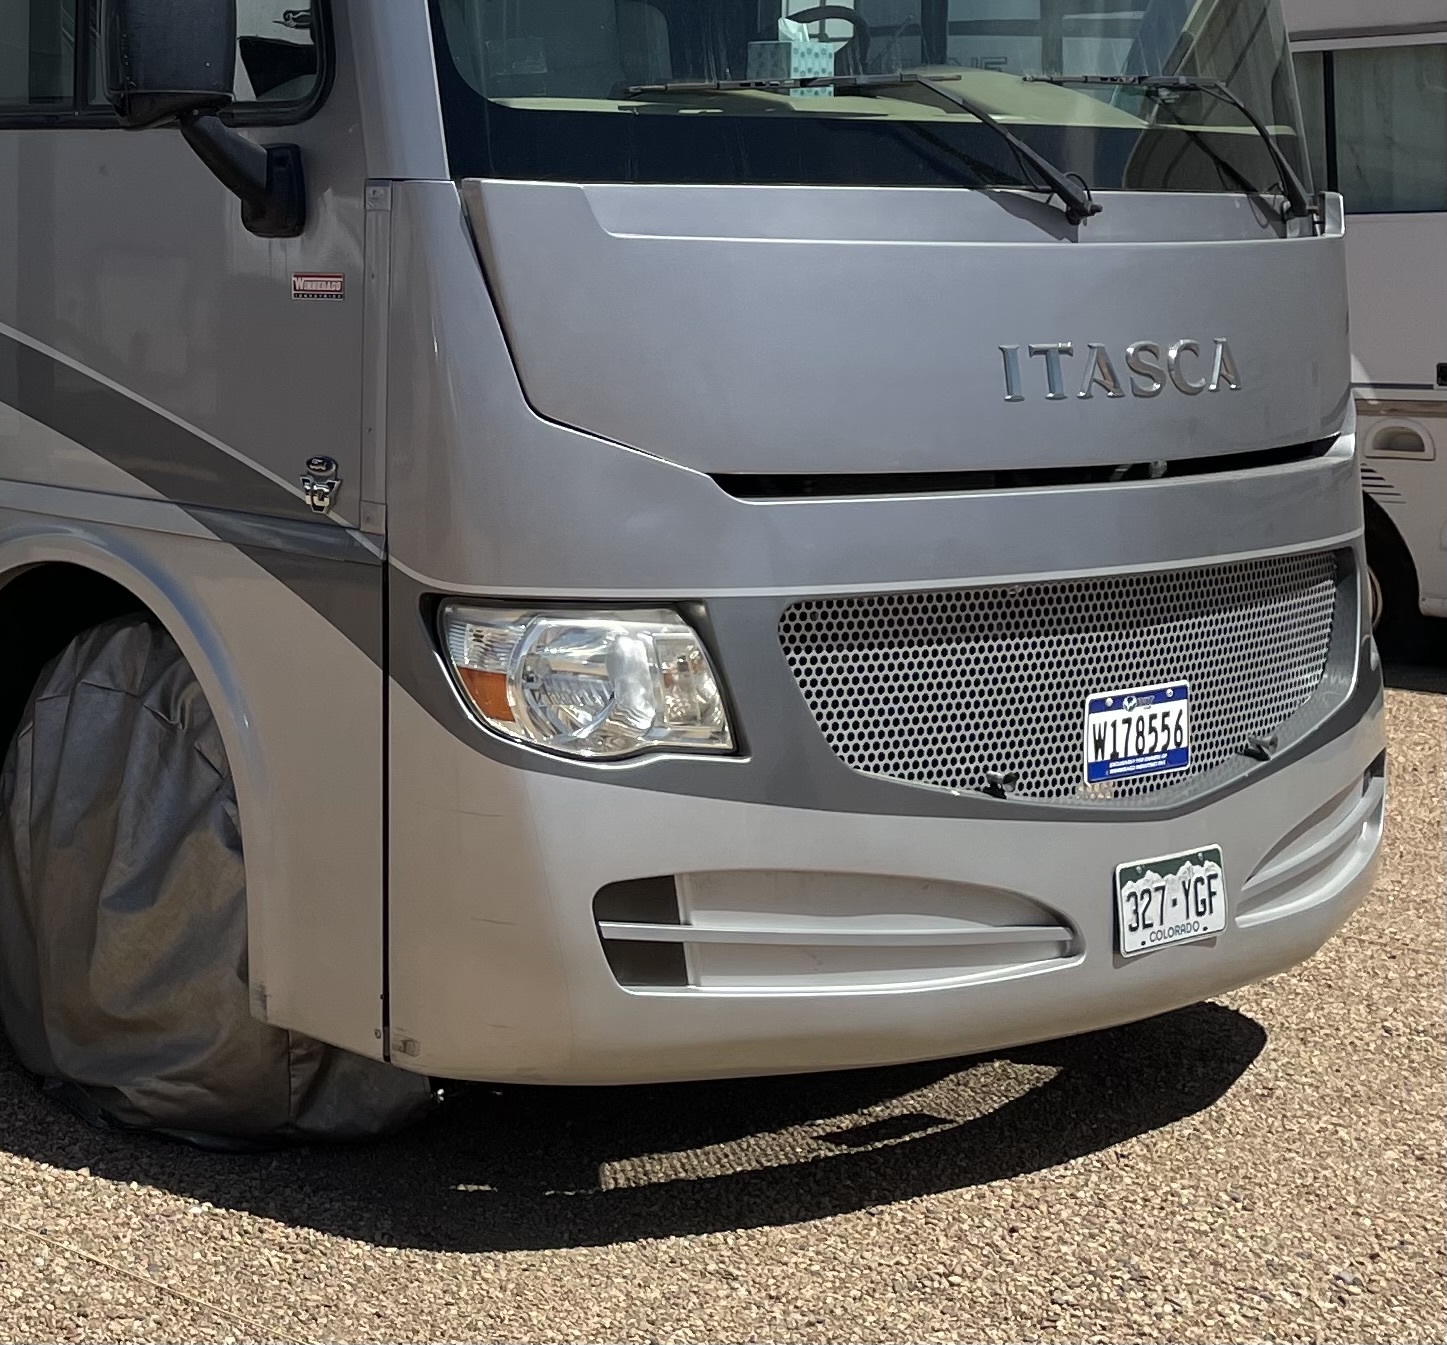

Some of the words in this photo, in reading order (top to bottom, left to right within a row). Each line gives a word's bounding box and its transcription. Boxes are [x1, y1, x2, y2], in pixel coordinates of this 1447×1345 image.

[998, 337, 1242, 402] ITASCA
[1092, 709, 1184, 761] W178556
[1125, 872, 1219, 933] 327-YGF
[1149, 920, 1200, 943] COLORADO
